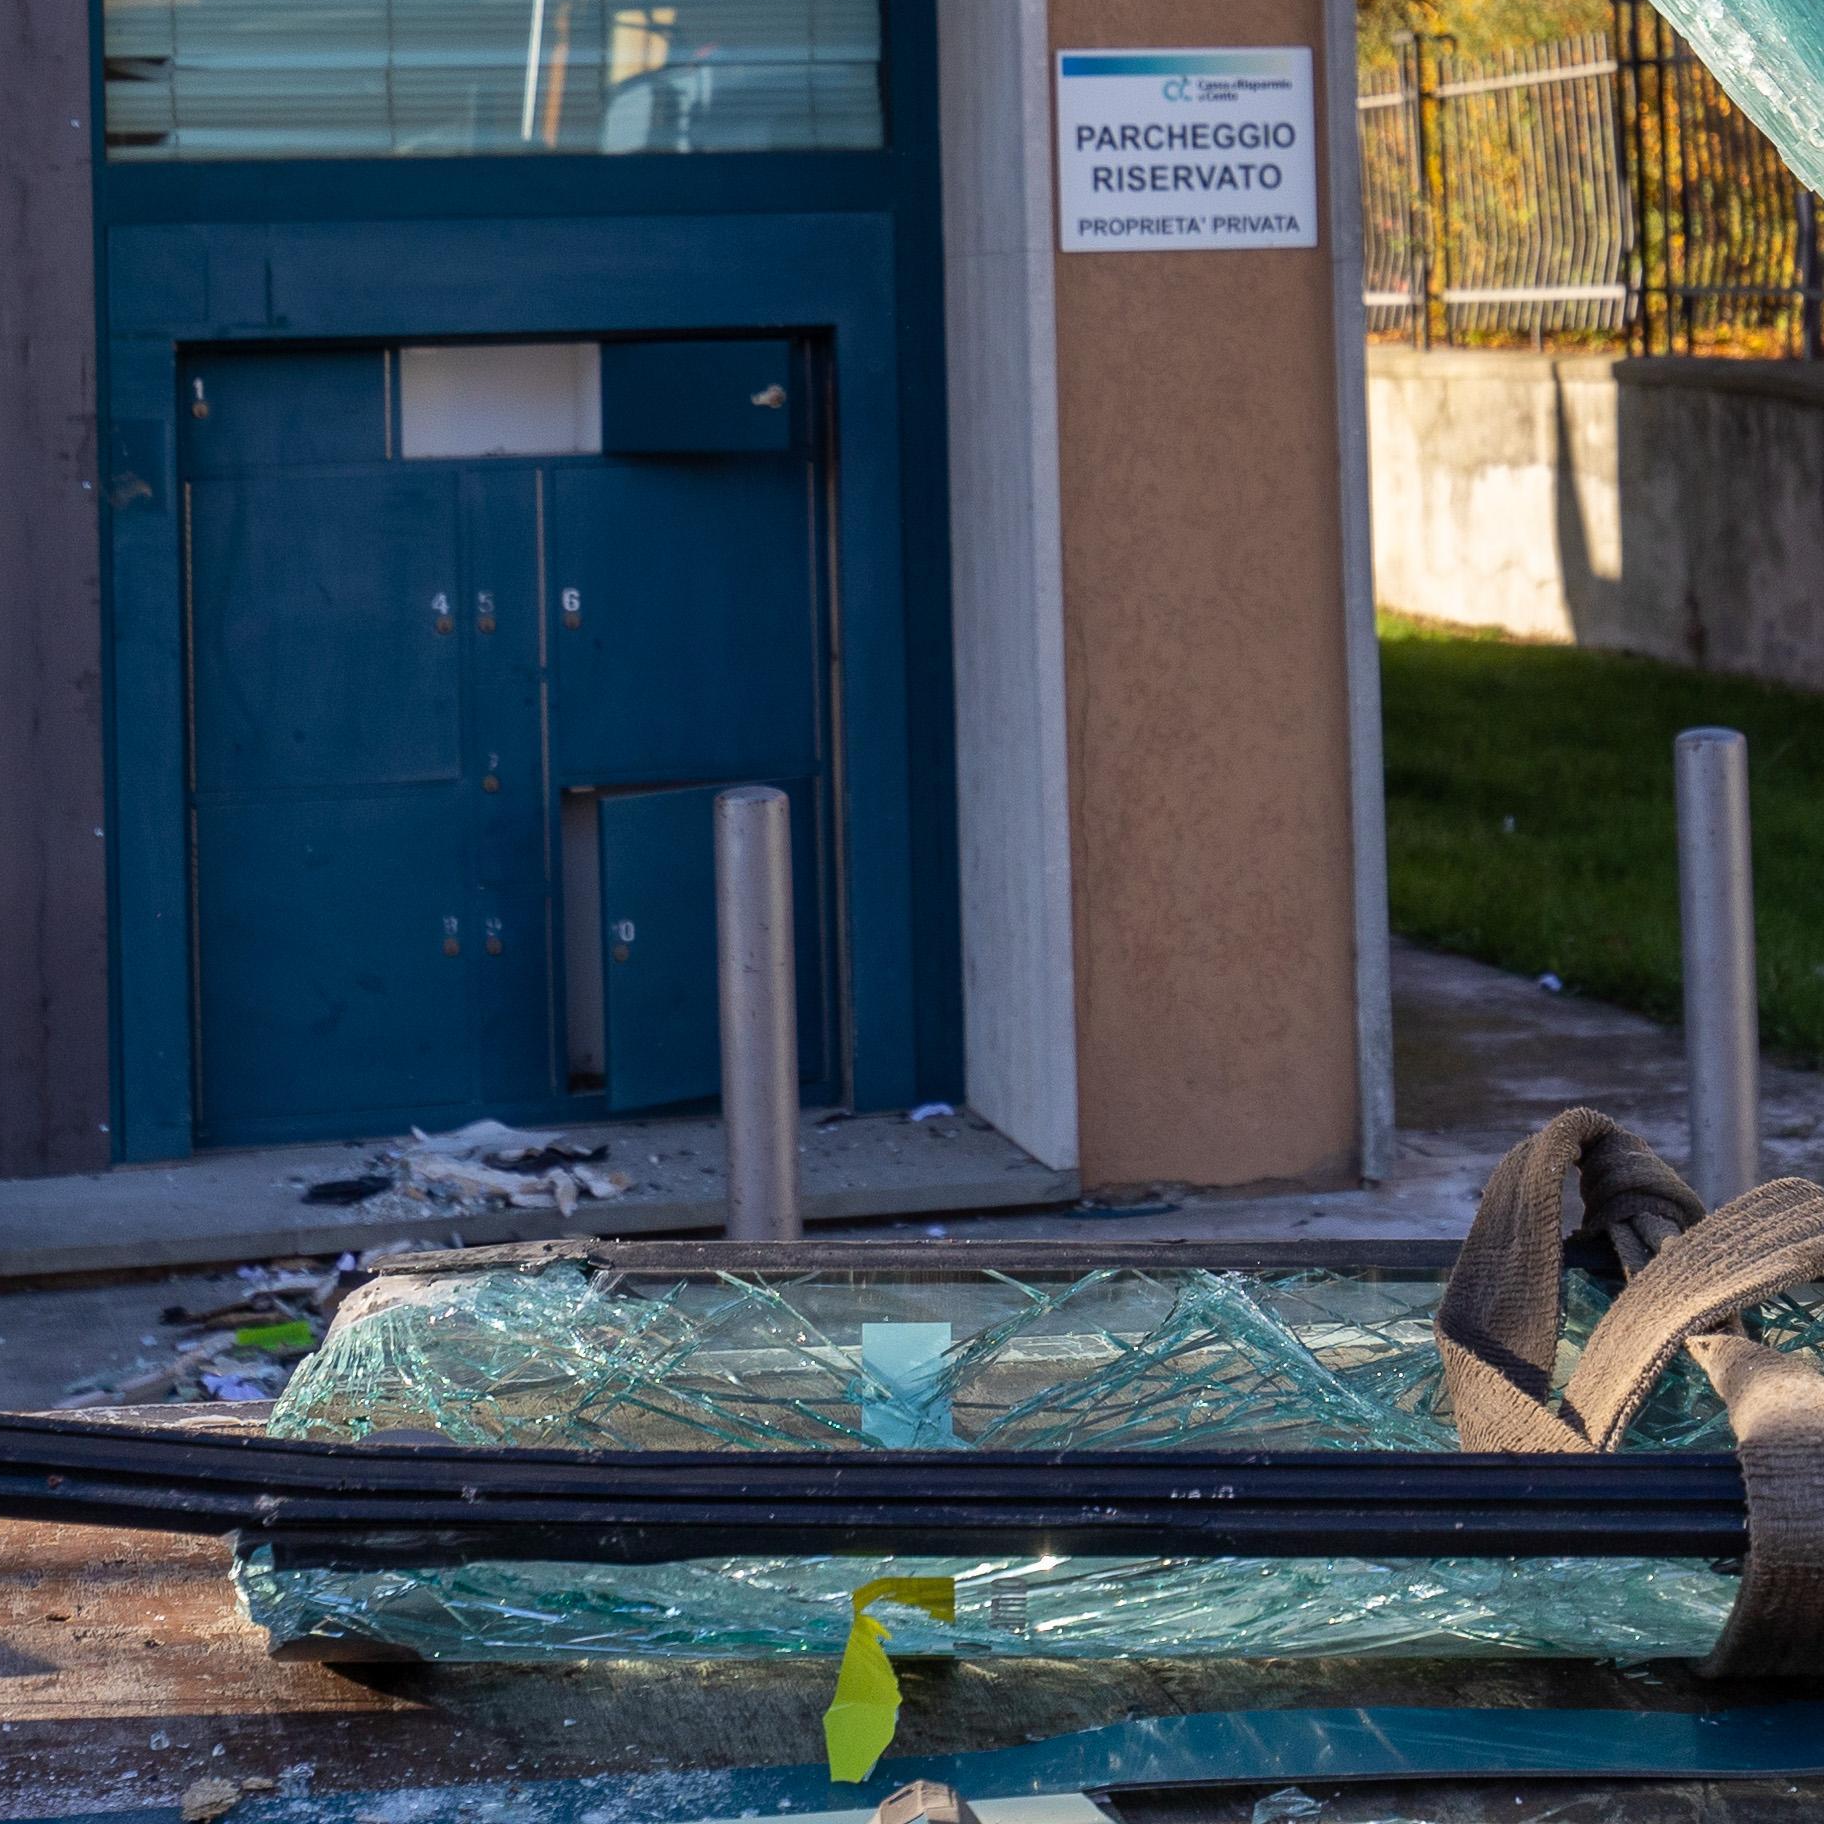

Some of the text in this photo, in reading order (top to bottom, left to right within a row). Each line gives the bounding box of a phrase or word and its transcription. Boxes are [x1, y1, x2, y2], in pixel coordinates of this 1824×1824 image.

[1076, 122, 1296, 152] PARCHEGGIO
[1092, 163, 1283, 193] RISERVATO
[1212, 214, 1301, 234] PRIVATA
[432, 592, 450, 614] 4
[478, 590, 495, 613] 5
[562, 587, 580, 612] 6
